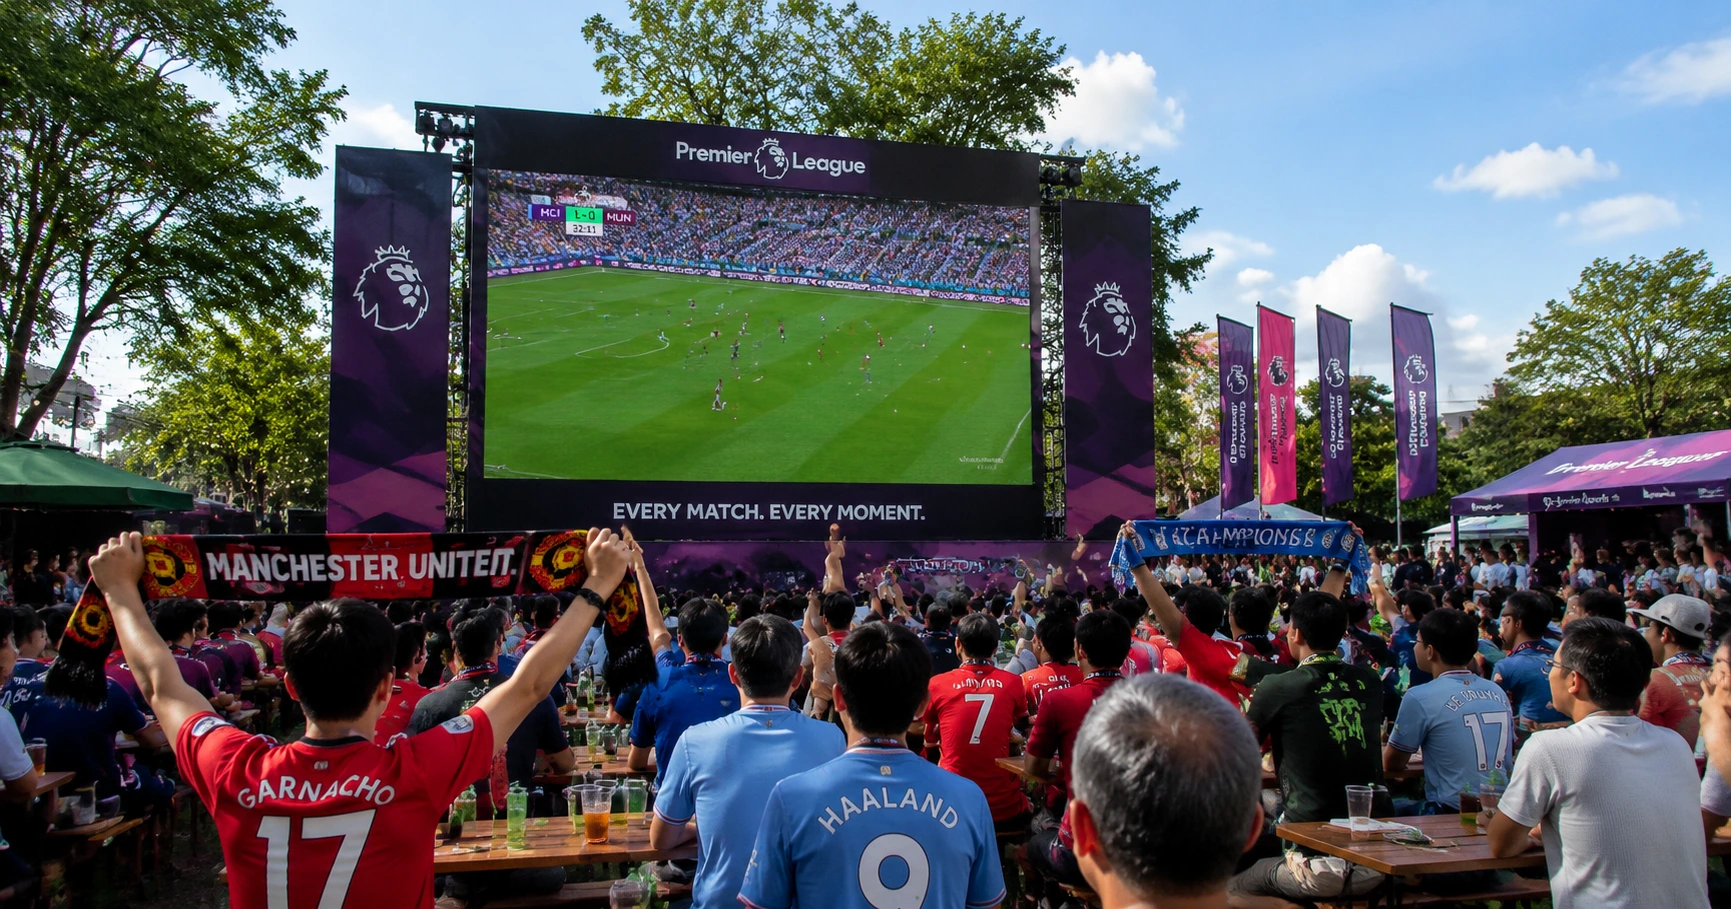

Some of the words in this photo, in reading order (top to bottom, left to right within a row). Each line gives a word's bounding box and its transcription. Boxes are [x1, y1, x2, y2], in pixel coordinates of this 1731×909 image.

[676, 141, 752, 165] Premier
[793, 152, 866, 177] League
[606, 212, 632, 223] MUN
[613, 502, 681, 519] EVERY
[687, 503, 764, 520] MATCH.
[769, 504, 833, 520] EVERY
[837, 504, 926, 521] MOMENT.
[206, 552, 399, 582] MANCHESTER
[964, 693, 995, 745] 7
[1462, 710, 1509, 772] 17
[237, 774, 396, 810] GARNACHO
[817, 786, 959, 835] HAALAND
[256, 808, 377, 909] 17
[858, 832, 930, 909] 9
